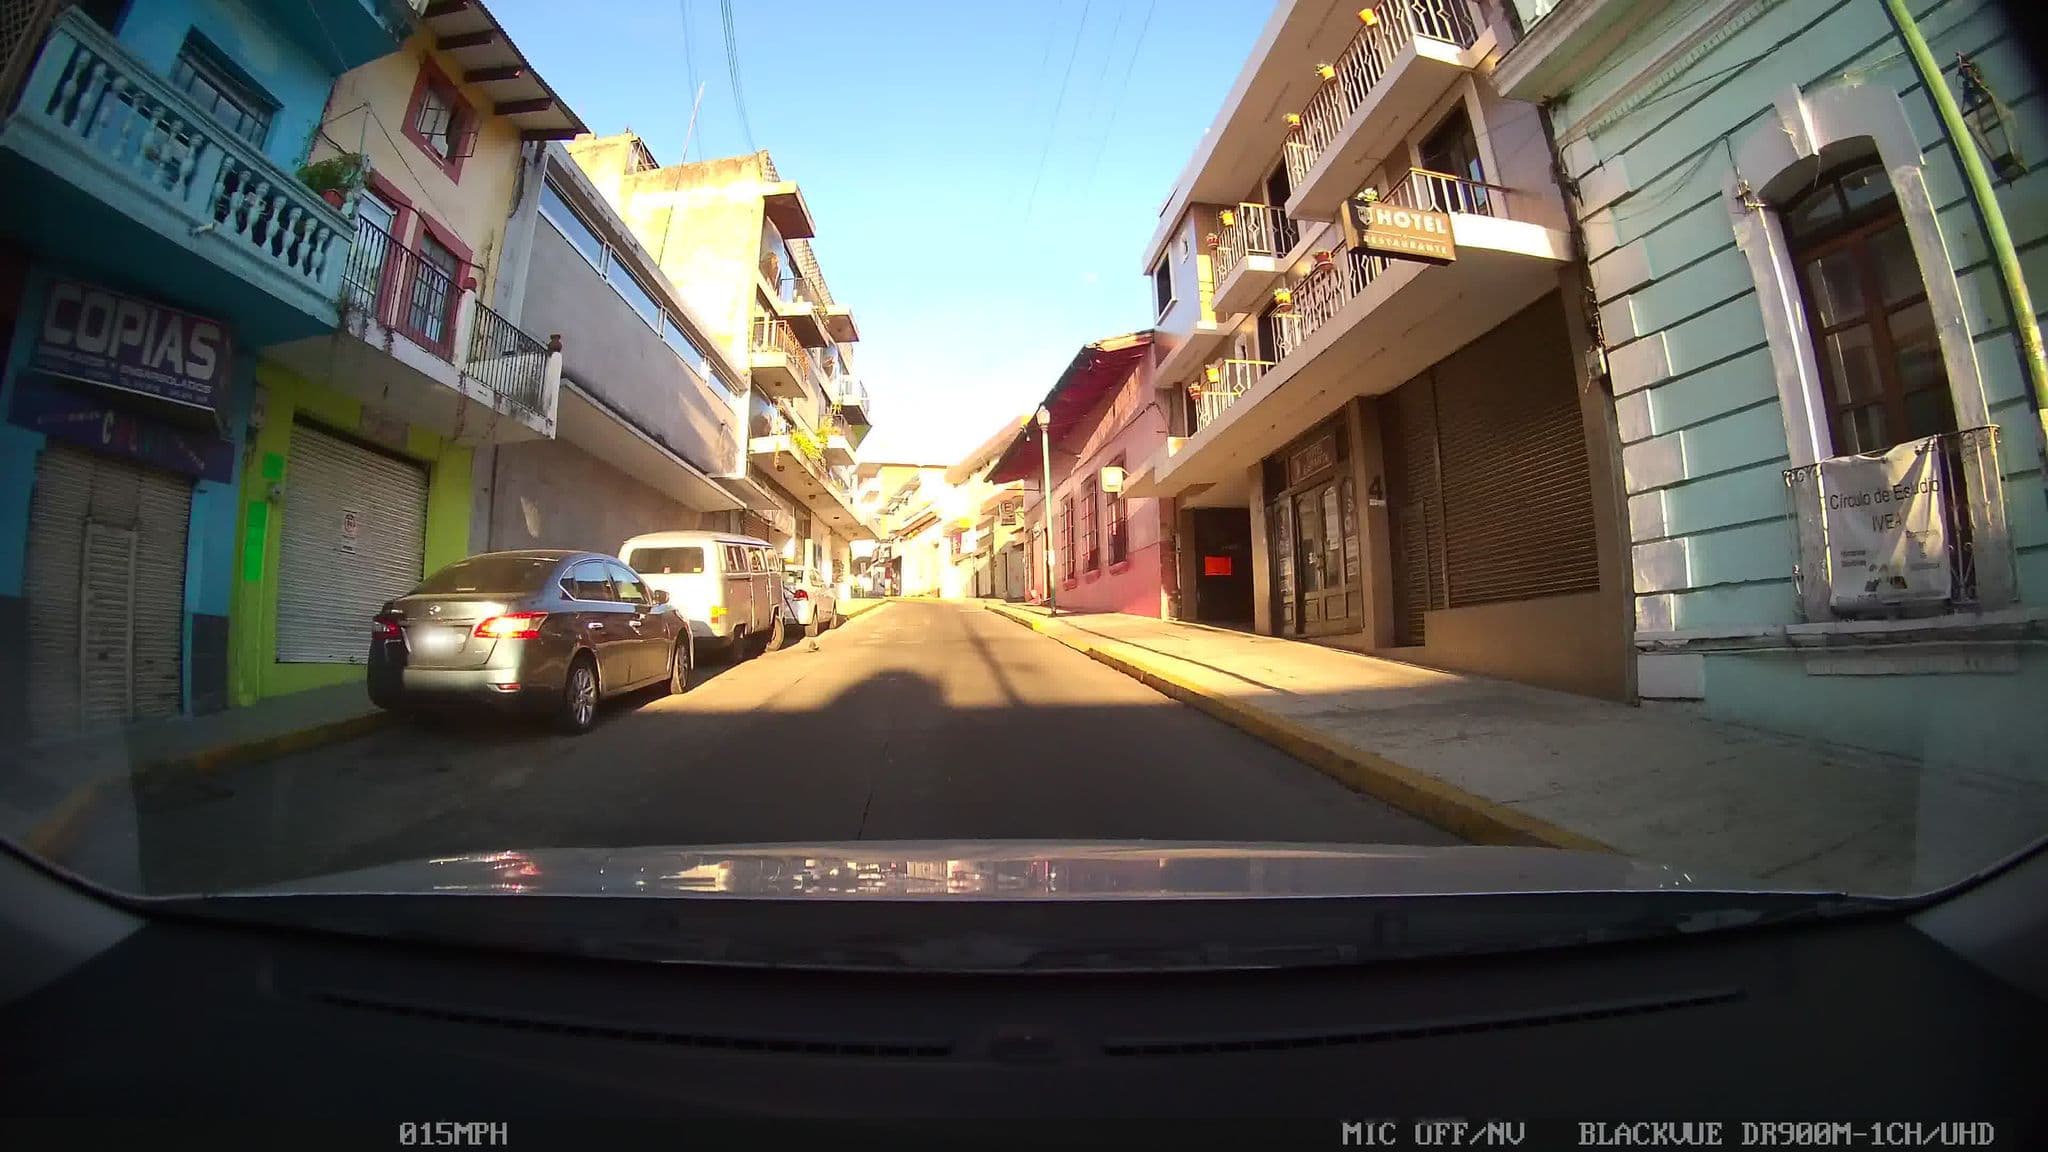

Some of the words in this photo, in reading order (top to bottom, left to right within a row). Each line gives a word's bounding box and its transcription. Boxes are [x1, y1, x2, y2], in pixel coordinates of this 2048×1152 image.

[1376, 208, 1447, 234] HOTEL
[1363, 235, 1448, 254] RESTAURANTE
[43, 285, 221, 381] COPIAS
[1369, 475, 1383, 500] 4
[1874, 487, 1890, 504] de
[1893, 478, 1940, 500] Esudio
